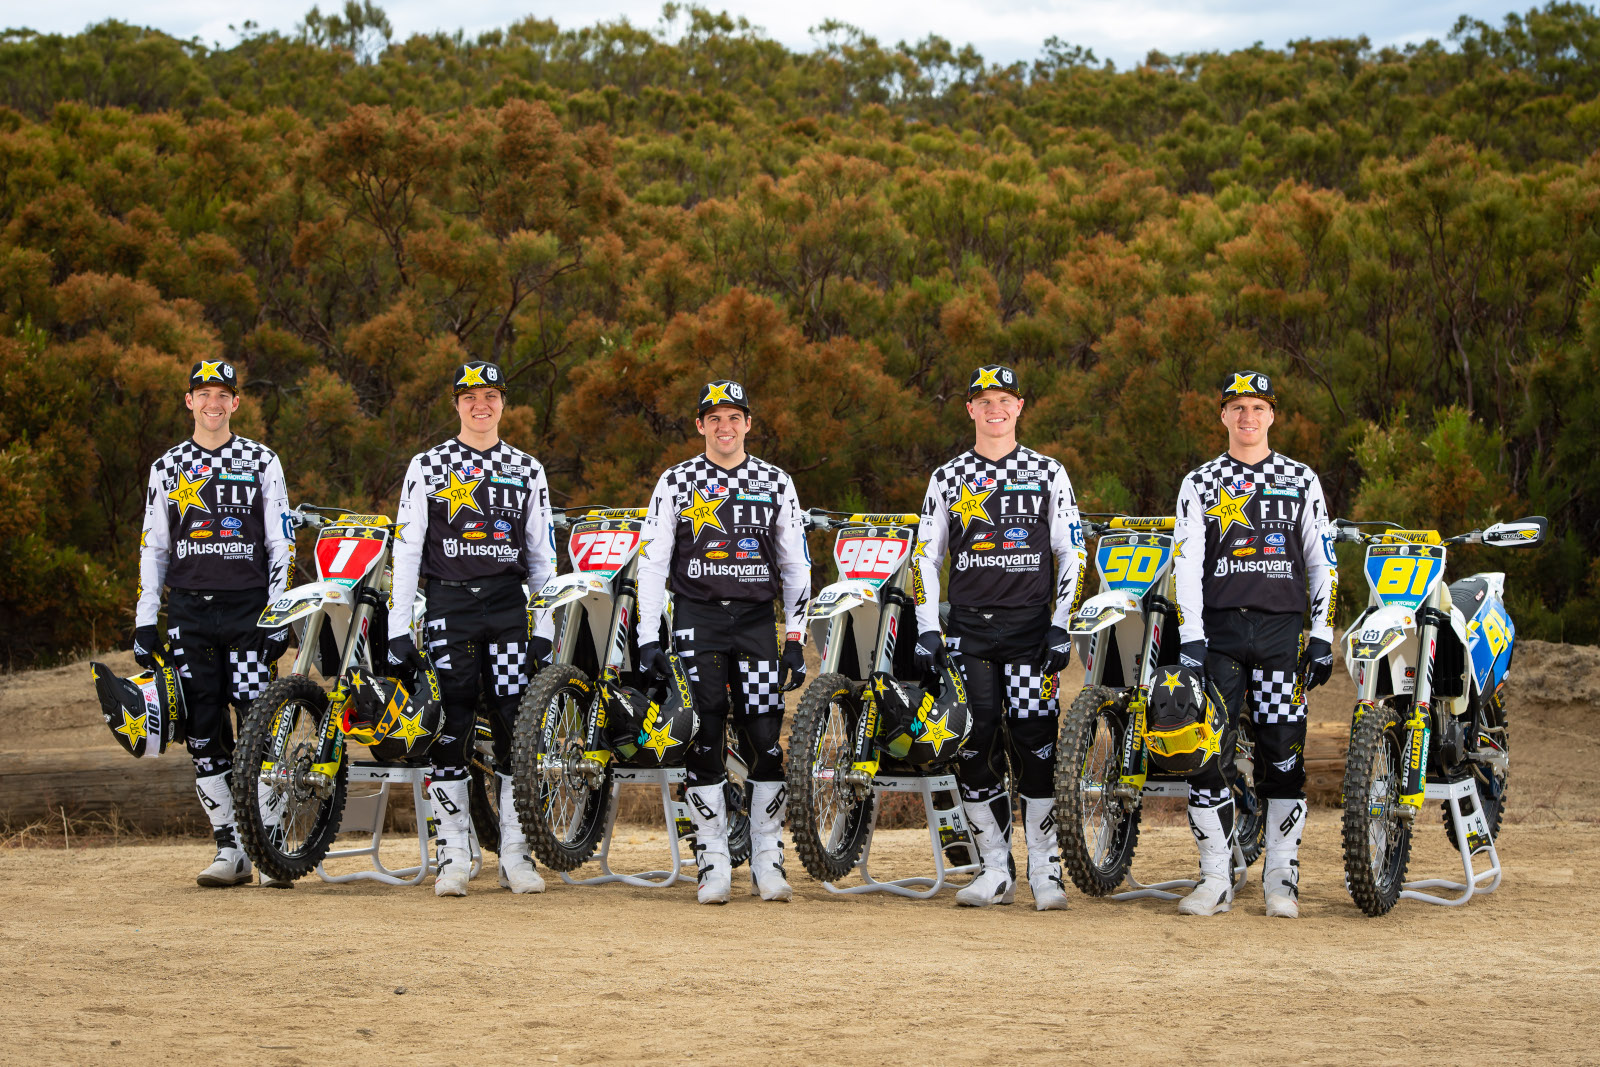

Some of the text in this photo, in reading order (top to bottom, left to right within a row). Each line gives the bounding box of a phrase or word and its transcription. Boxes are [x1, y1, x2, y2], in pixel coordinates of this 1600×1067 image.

[215, 485, 257, 506] FLY
[487, 486, 526, 509] FLY
[1000, 495, 1043, 515] FLY
[732, 505, 773, 526] FLY
[1259, 500, 1300, 522] FLY
[220, 529, 233, 537] RK
[328, 540, 360, 573] 1
[574, 532, 634, 565] 739
[839, 540, 903, 572] 989
[1003, 541, 1015, 549] RK
[703, 562, 769, 577] Husqvarna
[969, 552, 1040, 568] Husqvarna
[1103, 546, 1163, 583] 50
[1376, 558, 1434, 596] 81
[638, 701, 660, 746] 100%
[910, 692, 935, 735] 100%
[1420, 730, 1431, 776] MOTOREX
